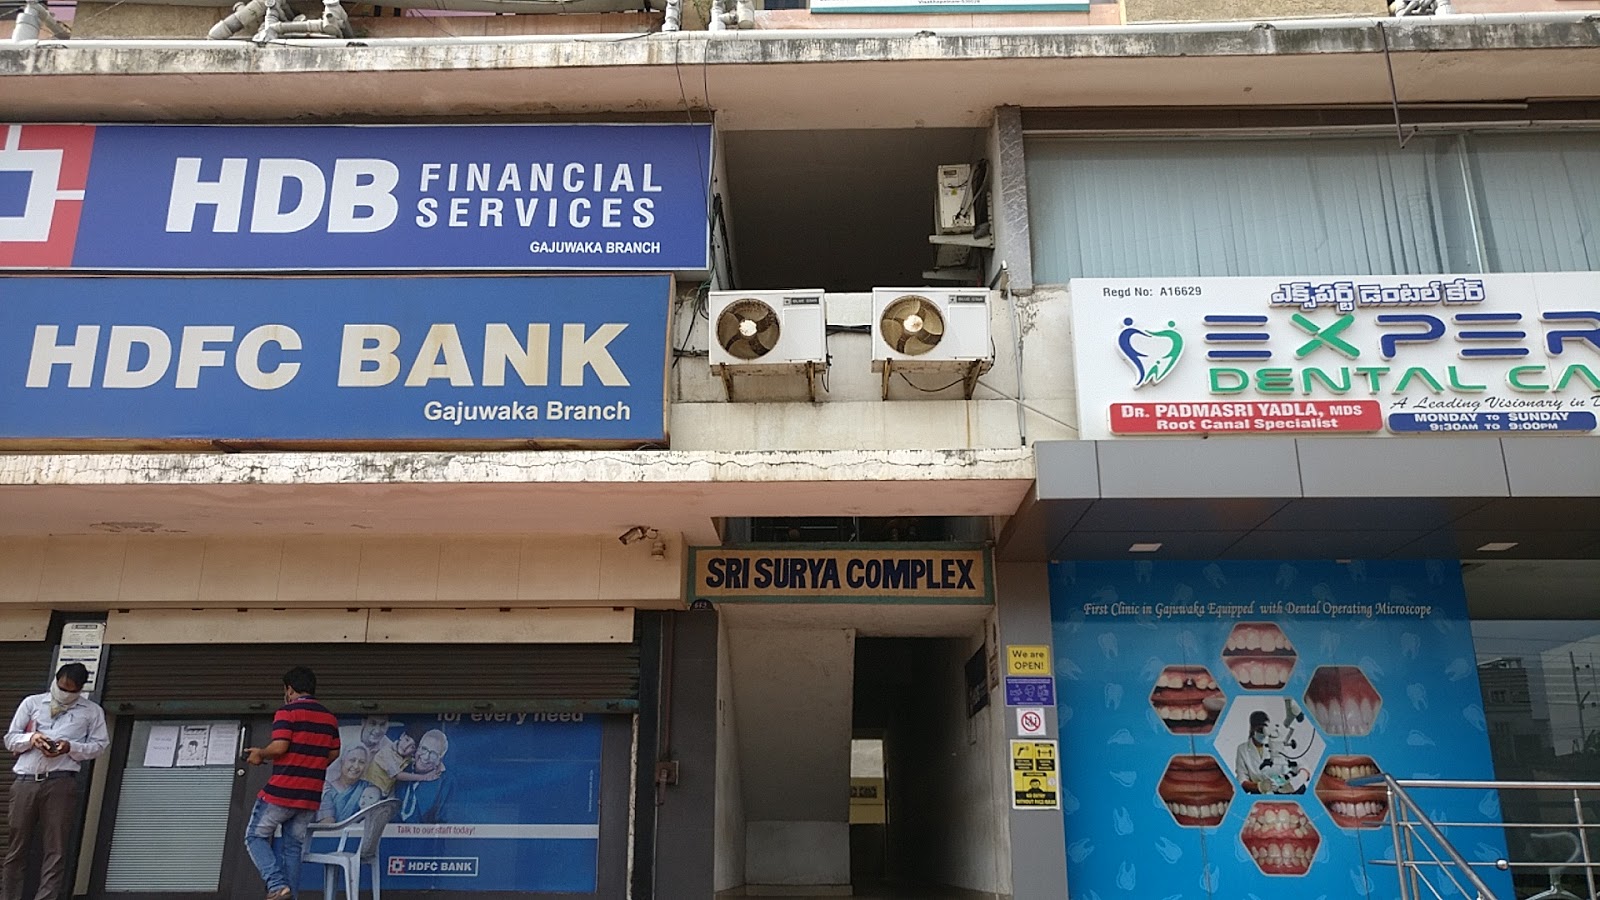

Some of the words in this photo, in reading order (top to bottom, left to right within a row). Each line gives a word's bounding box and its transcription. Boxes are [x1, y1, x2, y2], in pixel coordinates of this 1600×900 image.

[419, 162, 663, 193] FINANCIAL
[164, 157, 400, 234] HDB
[415, 197, 656, 229] SERVICES
[529, 240, 602, 255] GAJUWAKA
[605, 240, 661, 254] BRANCH
[1103, 287, 1130, 298] Regd
[1134, 287, 1153, 297] No:
[1160, 286, 1202, 297] A16629
[25, 325, 303, 390] HDFC
[337, 322, 631, 388] BANK
[1209, 365, 1487, 394] DENTAL
[1155, 403, 1254, 418] PADMASRI
[1257, 402, 1324, 419] YADLA,
[1330, 405, 1363, 416] MDS
[1390, 397, 1408, 410] A
[1412, 396, 1482, 412] Leading
[1484, 396, 1564, 411] Visionary
[1570, 397, 1586, 408] in
[424, 401, 539, 425] Gajuwaka
[546, 400, 631, 421] Branch
[1414, 413, 1478, 422] MONDAY
[1508, 412, 1570, 422] SUNDAY
[1156, 419, 1196, 430] Root
[1200, 419, 1250, 430] Canal
[1254, 418, 1339, 430] Specialist
[1429, 423, 1479, 431] 9:30AM
[1508, 422, 1559, 431] 9:00PM
[705, 557, 750, 590] SRI
[754, 557, 841, 590] SURYA
[846, 558, 976, 590] COMPLEX
[1084, 602, 1109, 616] First
[1111, 602, 1140, 615] Clinic
[1142, 603, 1152, 615] in
[1155, 602, 1205, 619] Gajuwaka
[1208, 602, 1255, 618] Equipped
[1260, 602, 1284, 615] with
[1285, 602, 1320, 615] Dental
[1323, 602, 1373, 618] Operating
[1375, 603, 1432, 618] Microscope
[1012, 650, 1028, 659] We
[1030, 651, 1045, 659] are
[1014, 661, 1044, 670] OPEN!
[471, 712, 527, 725] every
[397, 826, 412, 834] Talk
[413, 826, 421, 834] to
[434, 826, 452, 834] staff
[453, 826, 476, 836] today!
[408, 861, 438, 871] HDFC
[440, 862, 473, 871] BANK
